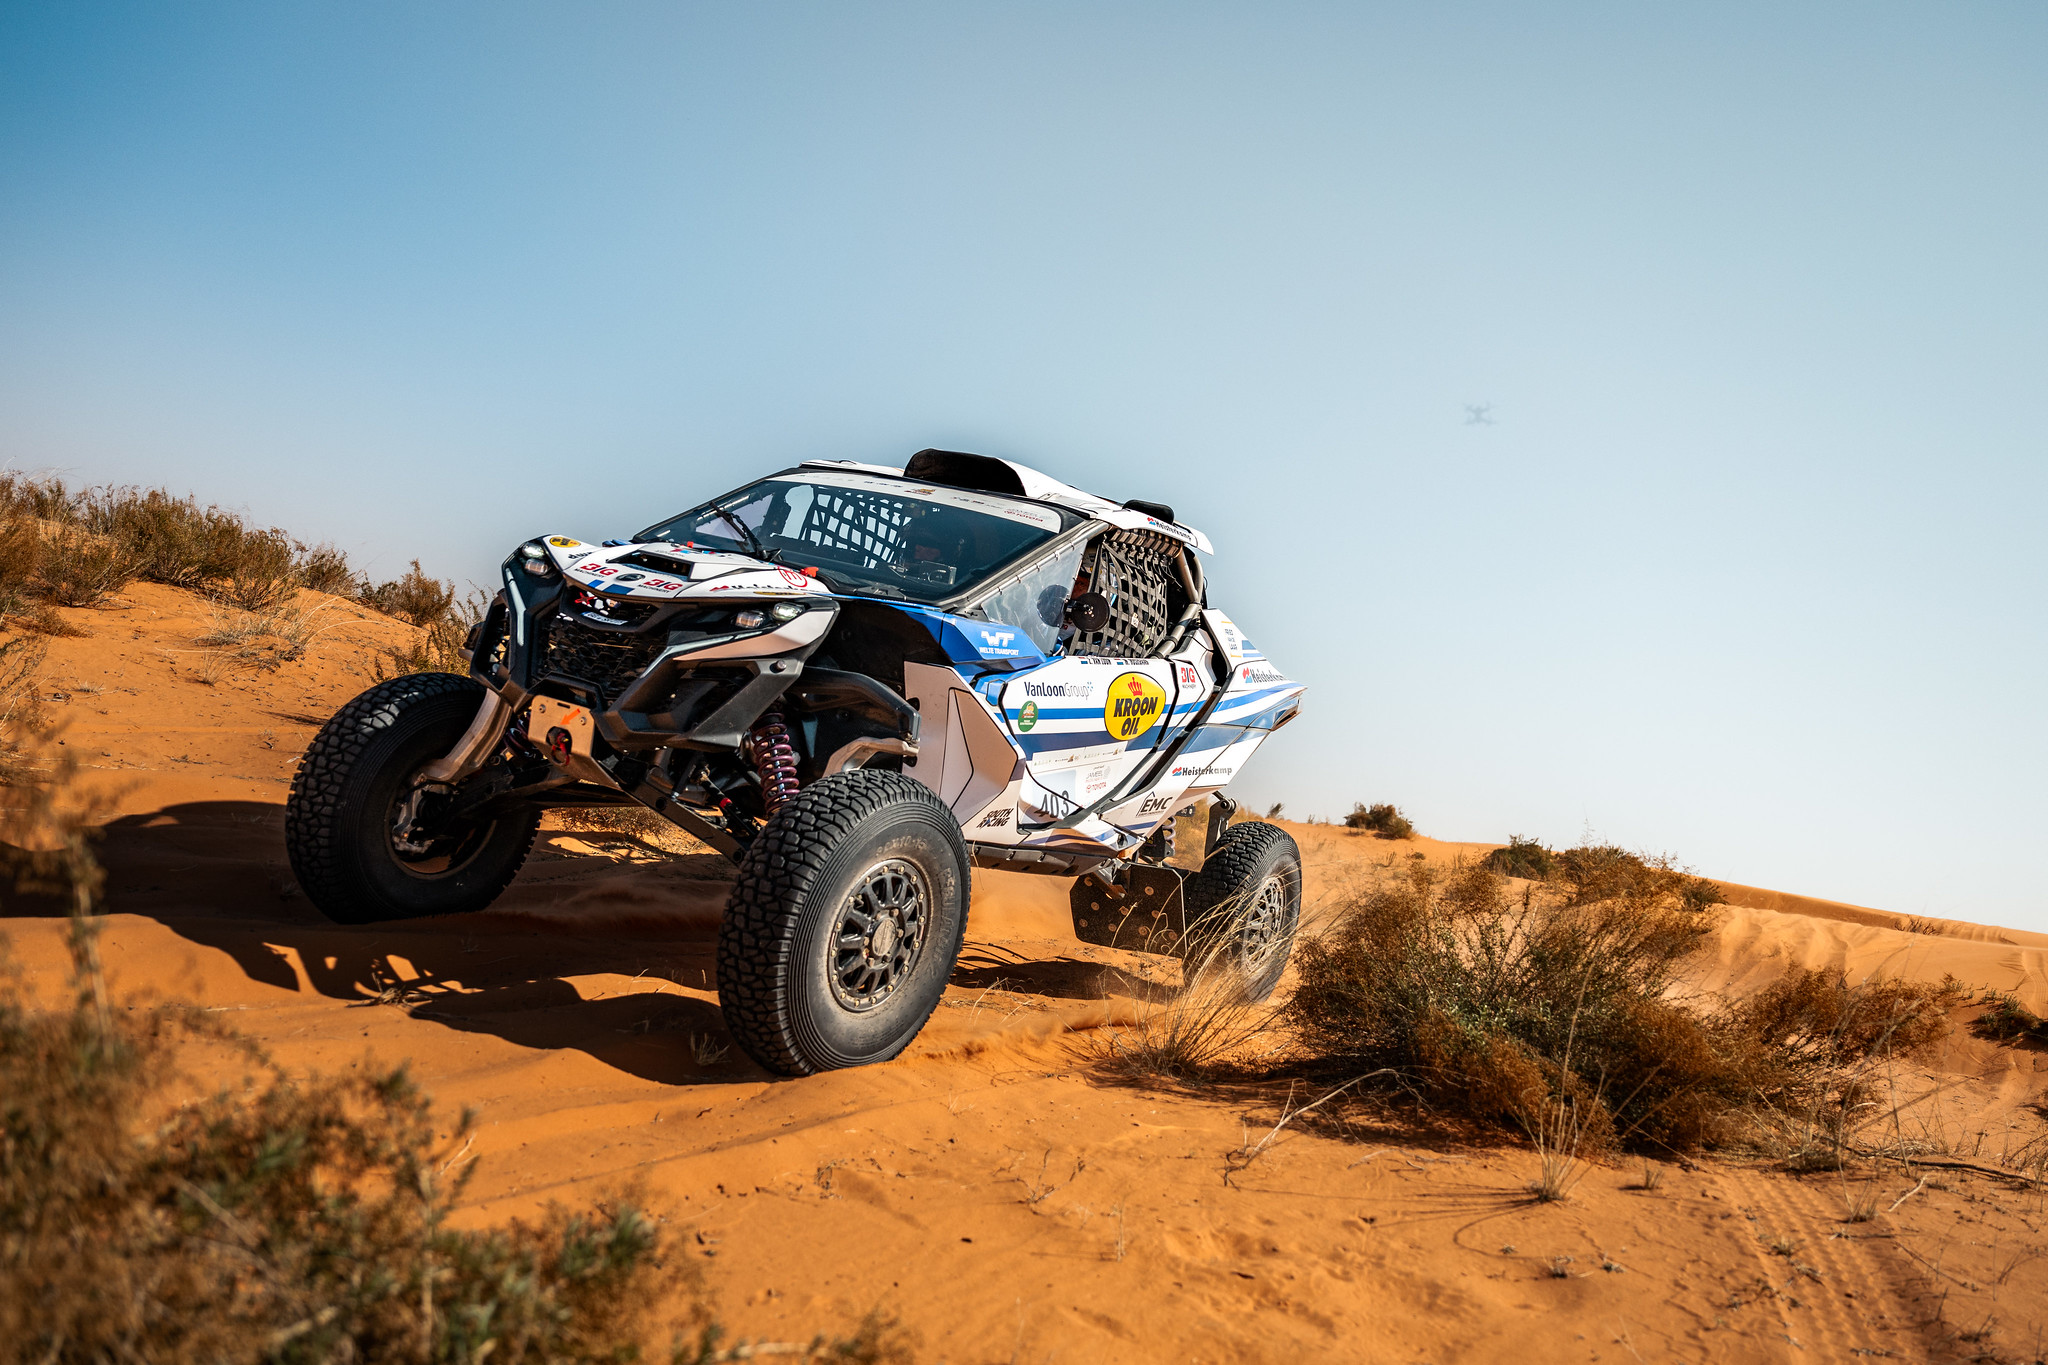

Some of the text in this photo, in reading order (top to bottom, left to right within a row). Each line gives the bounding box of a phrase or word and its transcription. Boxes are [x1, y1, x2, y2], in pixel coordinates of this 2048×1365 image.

[1113, 697, 1159, 718] KROON
[1121, 717, 1141, 737] OIL
[1182, 766, 1233, 776] Heisterkamp
[1033, 790, 1070, 819] 403
[1140, 797, 1173, 813] EMC
